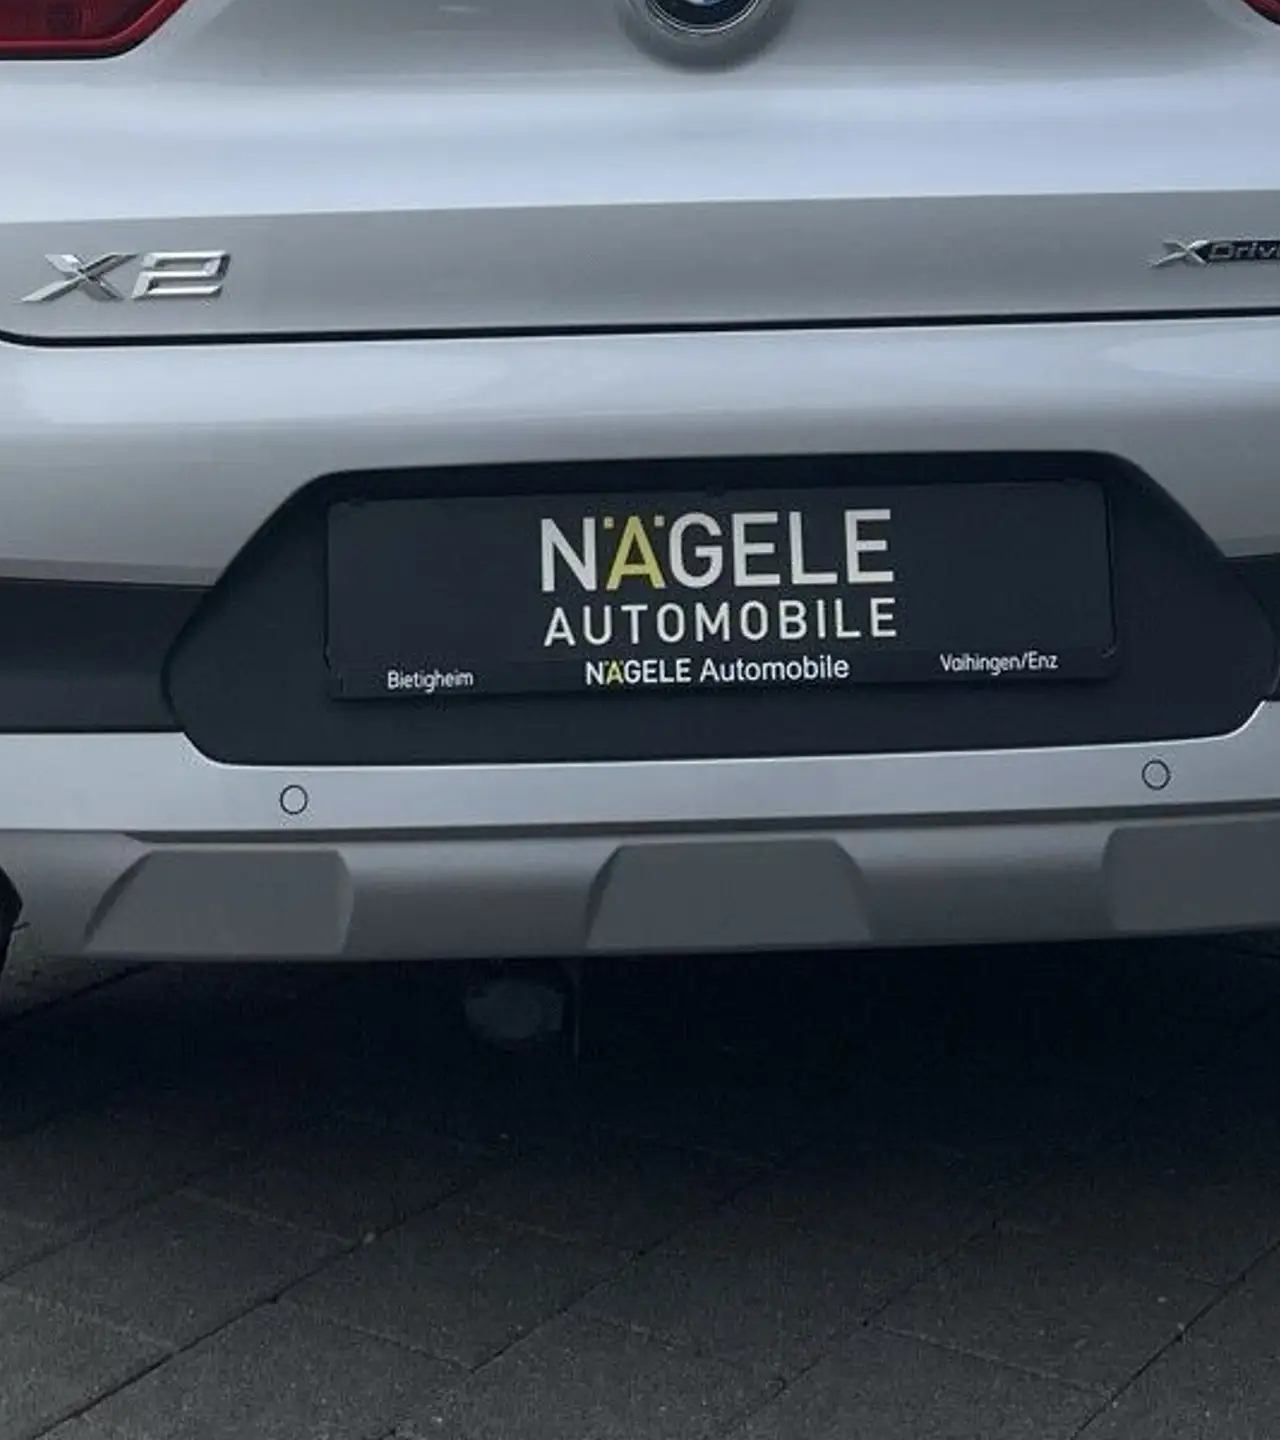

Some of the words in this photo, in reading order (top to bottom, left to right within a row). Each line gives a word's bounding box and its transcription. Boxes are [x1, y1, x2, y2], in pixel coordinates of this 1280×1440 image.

[20, 250, 231, 302] X2
[540, 509, 895, 593] NÄGELE
[544, 597, 897, 647] AUTOMOBILE
[387, 668, 474, 694] Bietigheim
[585, 658, 692, 685] NÄGELE
[699, 654, 850, 682] Automobile
[939, 650, 1059, 676] Vaihingen/Enz
